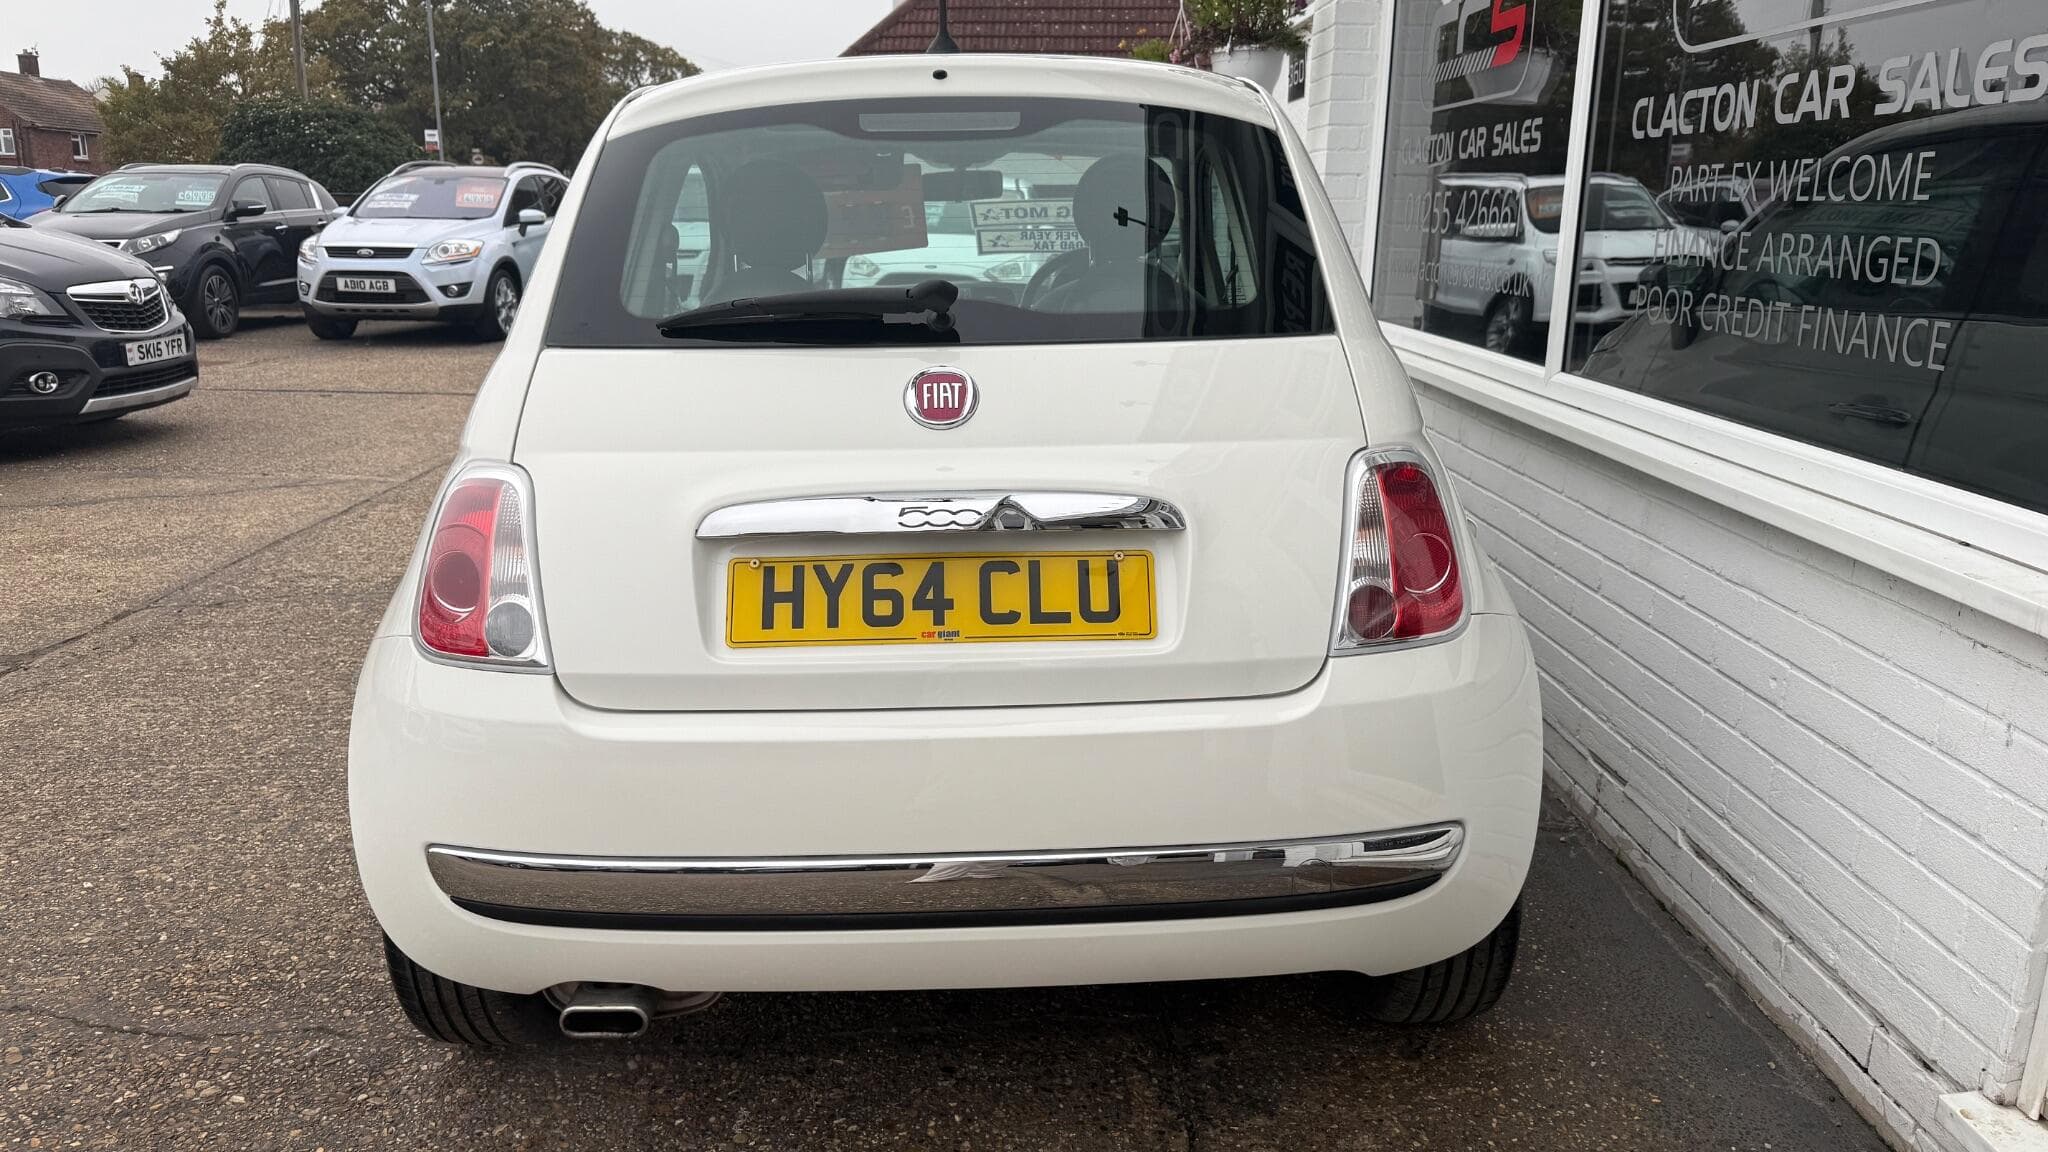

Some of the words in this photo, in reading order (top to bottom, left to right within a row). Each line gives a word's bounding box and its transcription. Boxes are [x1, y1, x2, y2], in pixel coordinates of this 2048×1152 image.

[1632, 79, 1760, 140] CLACTON
[1775, 64, 1856, 124] CAR
[1874, 33, 2048, 116] SALES
[1401, 130, 1455, 165] CLACTON
[1458, 126, 1487, 160] CAR
[1492, 117, 1543, 157] SALES
[1669, 162, 1724, 202] PART
[1730, 160, 1763, 202] EX
[1770, 151, 1936, 202] WELCOME
[1404, 191, 1452, 235] 01255
[1455, 187, 1524, 237] 426661
[1652, 228, 1752, 272] FINANCE
[1756, 231, 1941, 287] ARRANGED
[137, 342, 163, 360] SK15
[165, 338, 184, 356] YFR
[1635, 284, 1692, 328] POOR
[1700, 292, 1791, 344] CREDIT
[1798, 304, 1952, 372] FINANCE
[922, 382, 963, 410] FIAT
[898, 505, 983, 528] 500
[760, 560, 955, 631] HY64
[978, 558, 1122, 625] CLU
[921, 630, 936, 639] car
[937, 629, 960, 640] giant
